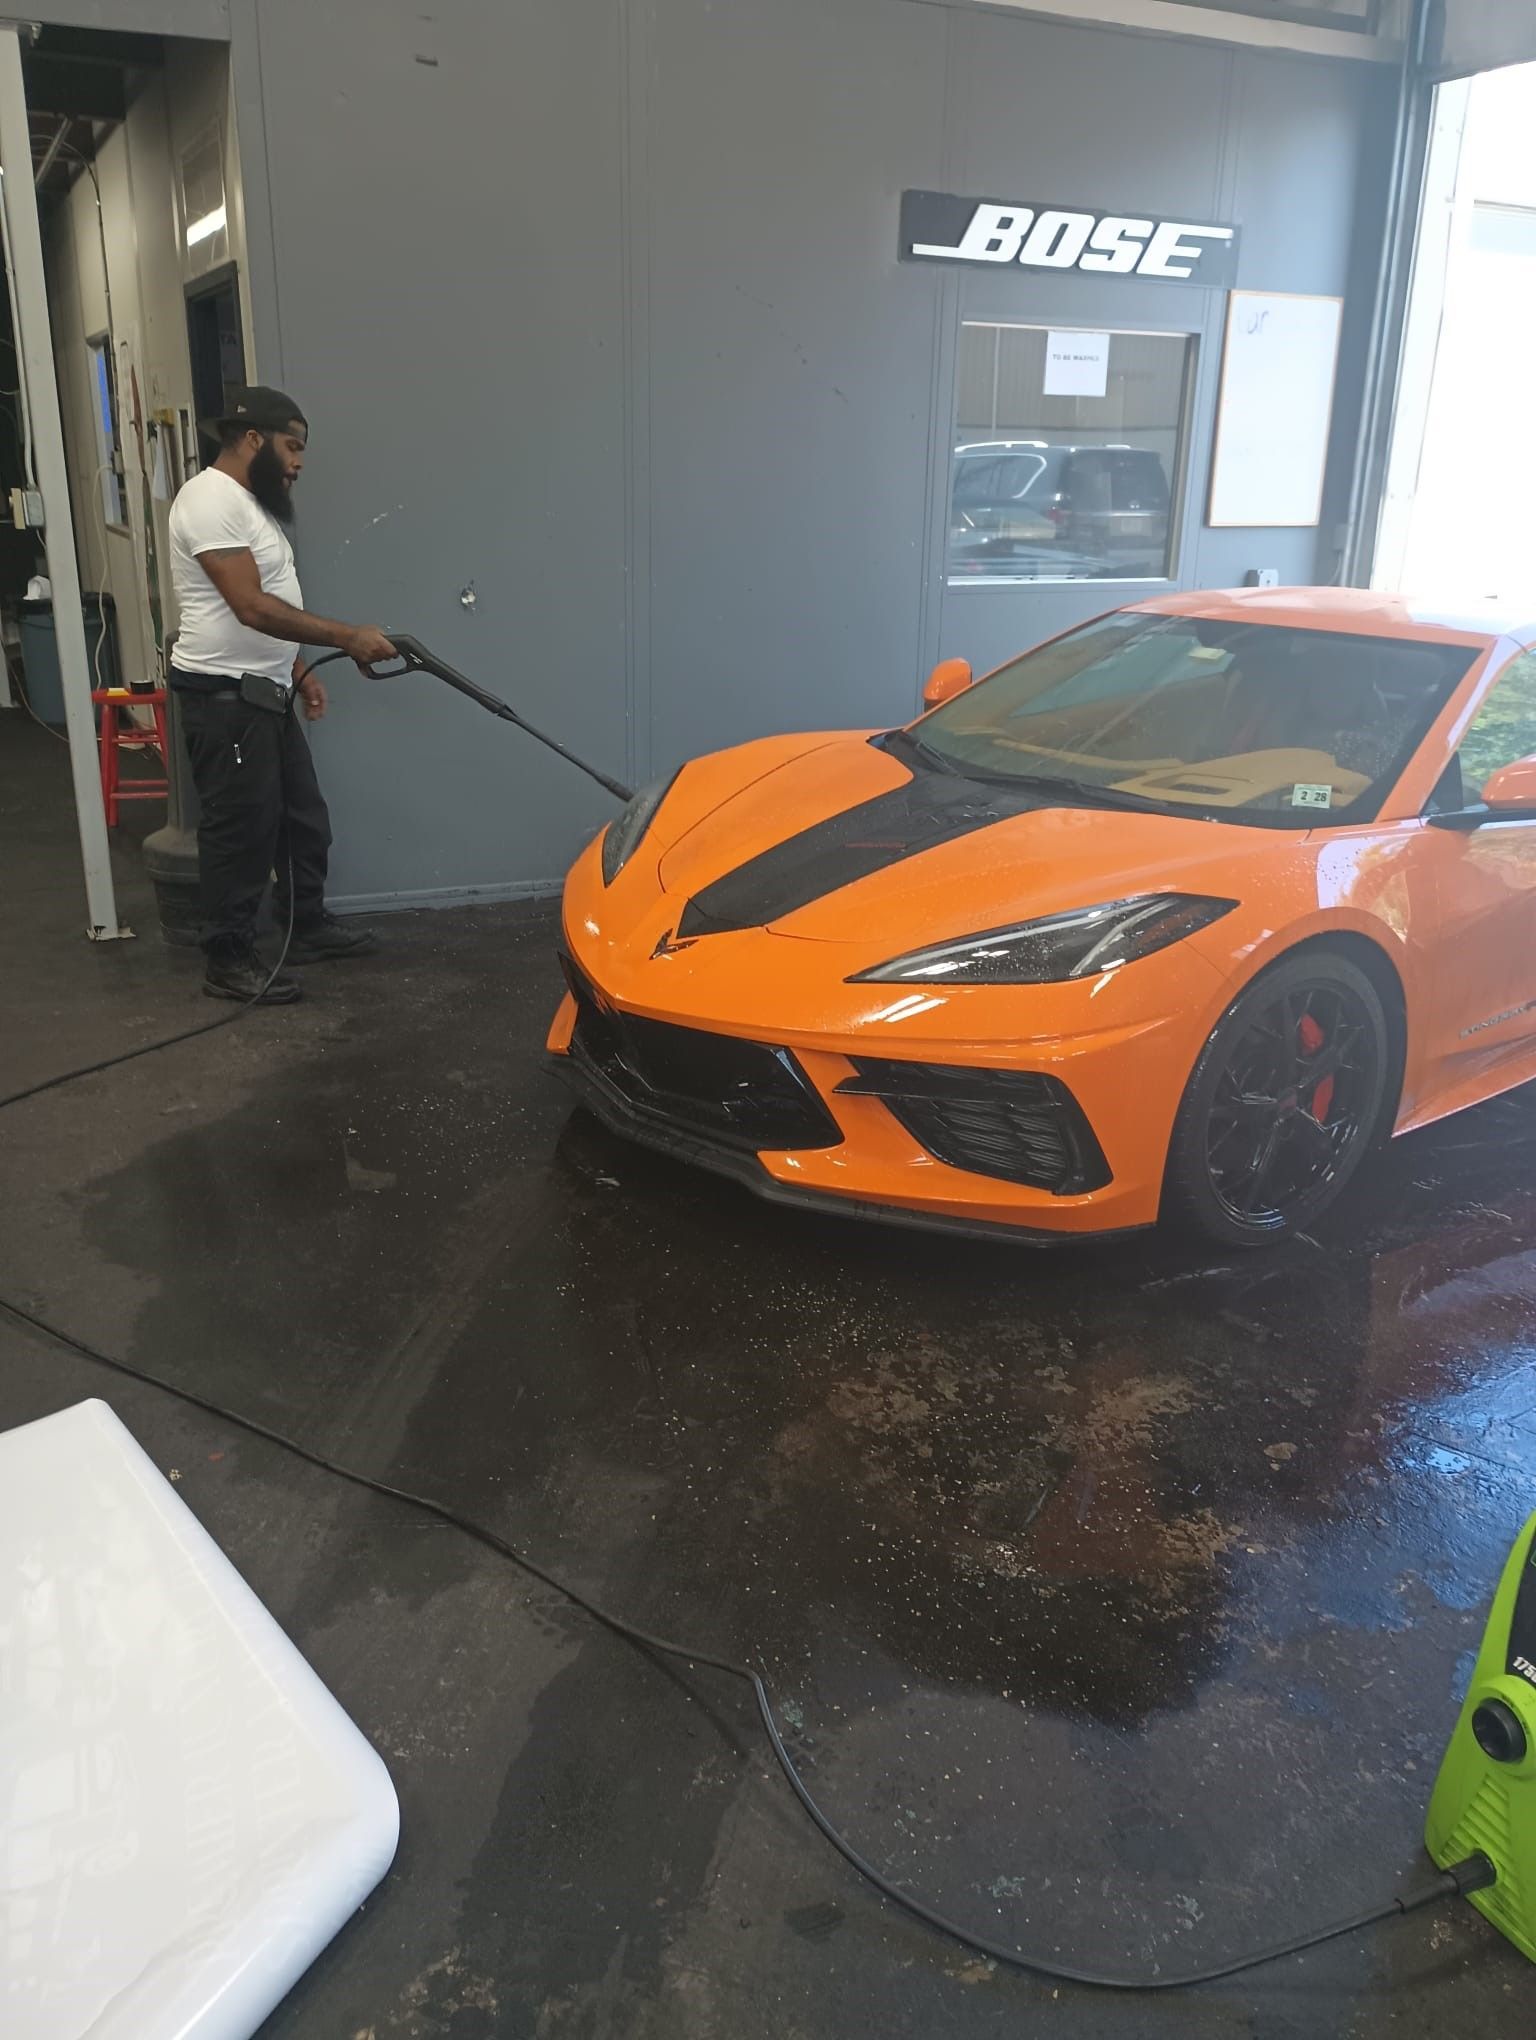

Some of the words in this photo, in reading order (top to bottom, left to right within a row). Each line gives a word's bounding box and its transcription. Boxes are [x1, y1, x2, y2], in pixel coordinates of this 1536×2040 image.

[912, 203, 1233, 278] BOSE
[1300, 791, 1308, 800] 2
[1314, 792, 1327, 801] 28
